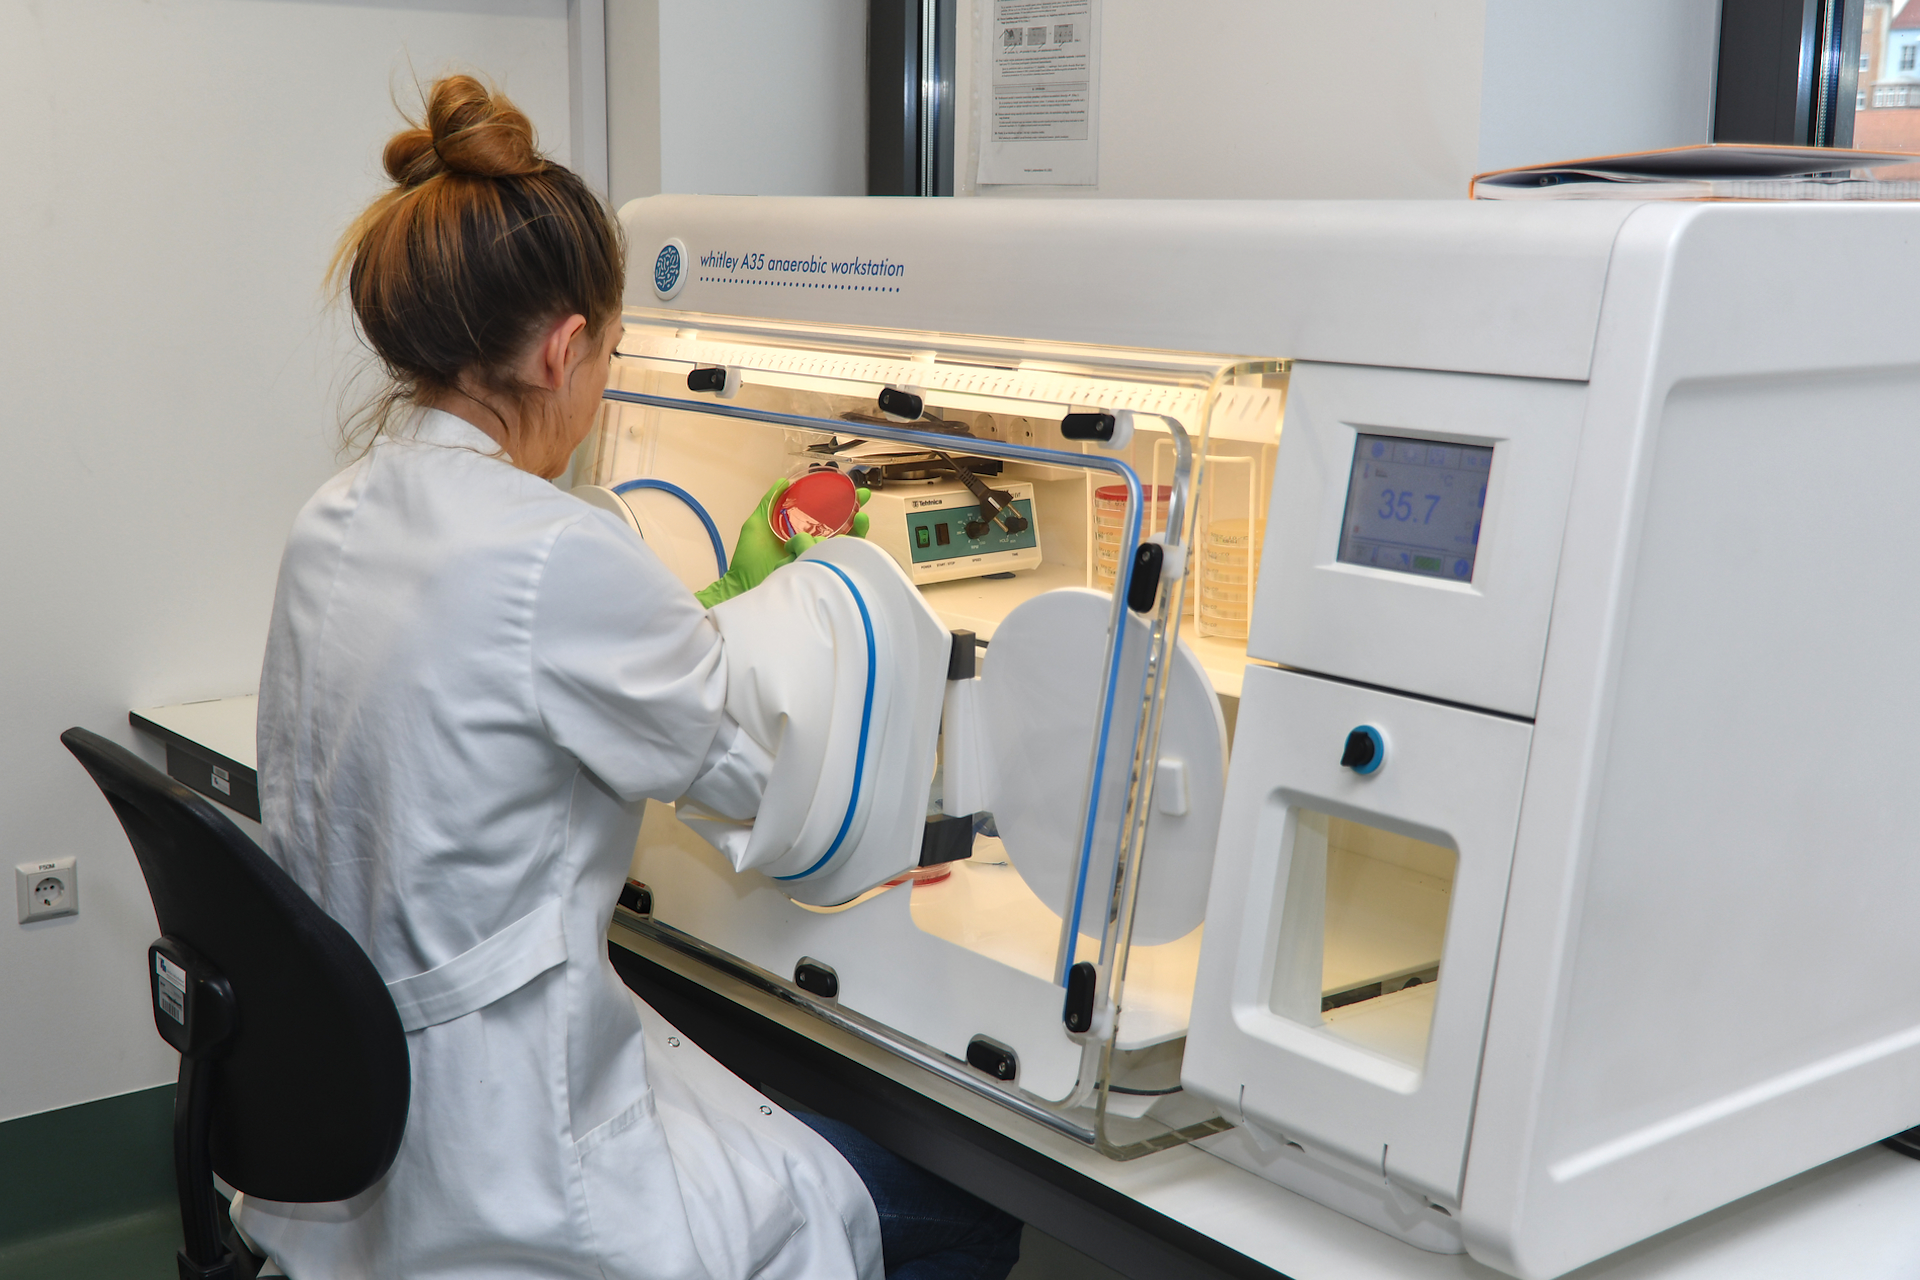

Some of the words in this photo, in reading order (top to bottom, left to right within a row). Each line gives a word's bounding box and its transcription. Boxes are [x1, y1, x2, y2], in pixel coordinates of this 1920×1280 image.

[700, 250, 738, 273] whitley
[741, 253, 765, 271] A35
[768, 254, 828, 274] anaerobic
[831, 256, 905, 277] workstation
[1378, 488, 1441, 525] 35.7
